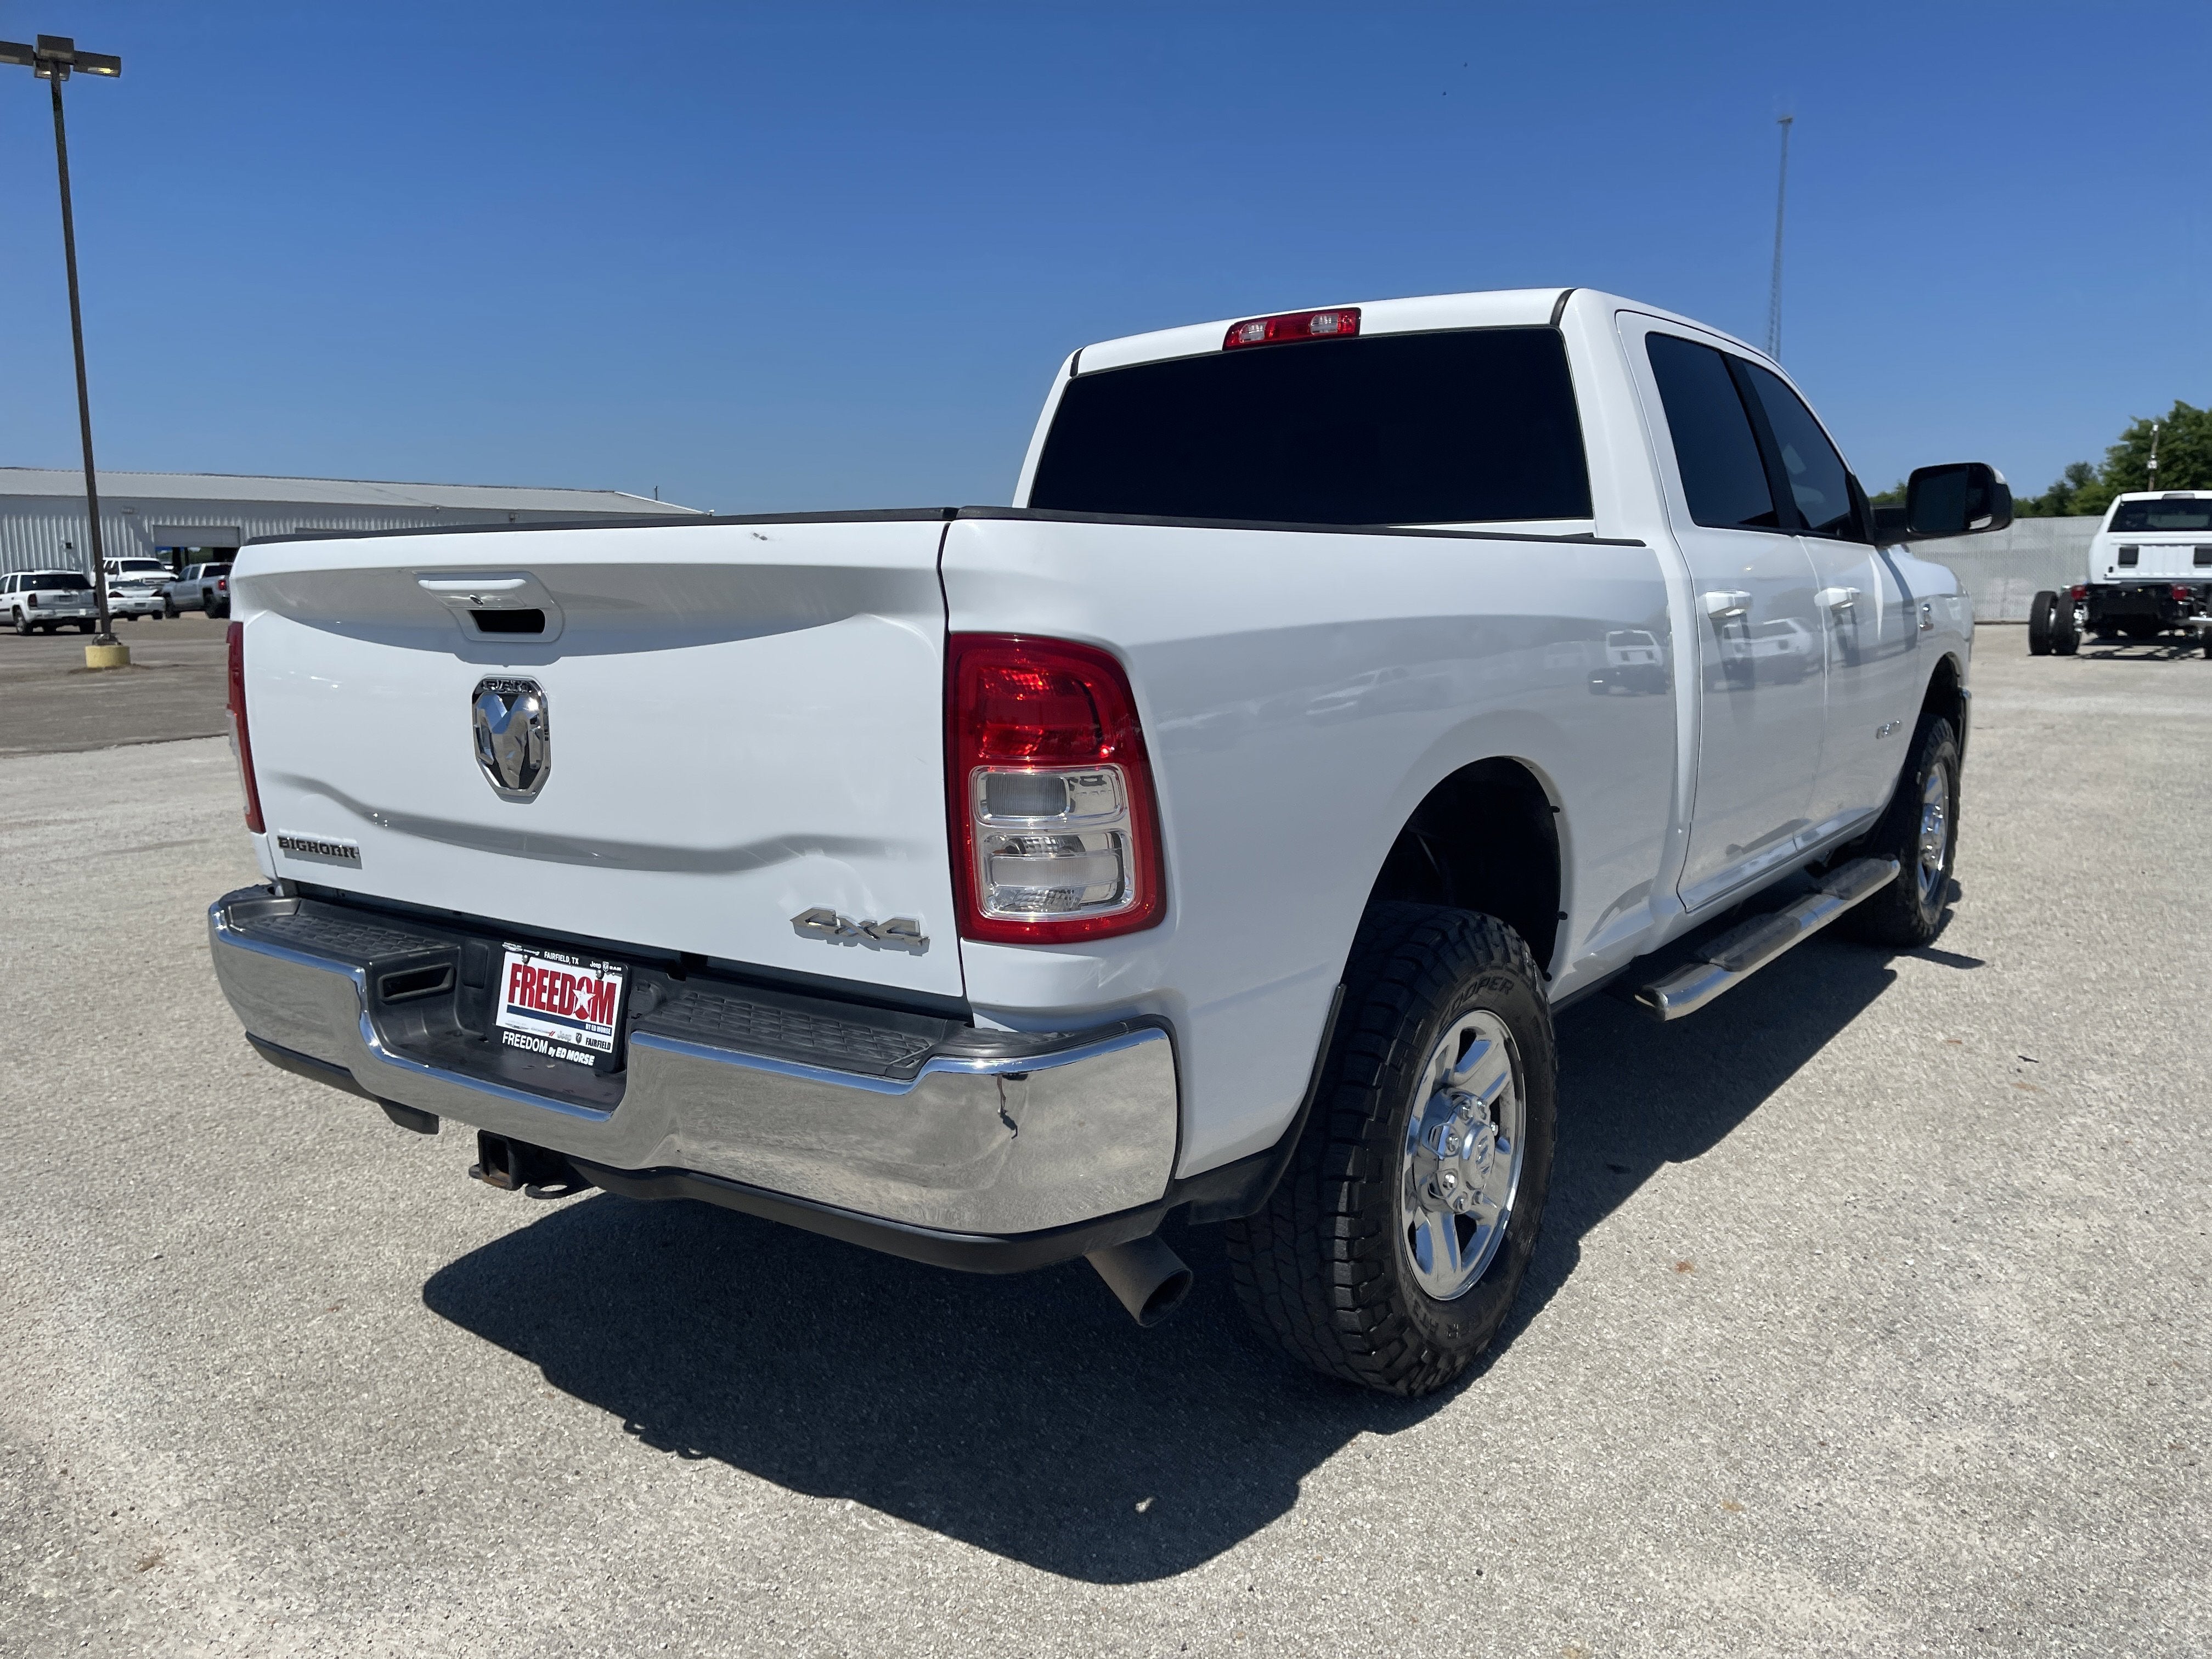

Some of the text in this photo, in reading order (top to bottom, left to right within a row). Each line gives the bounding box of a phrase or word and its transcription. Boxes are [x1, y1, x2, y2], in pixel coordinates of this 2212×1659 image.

[544, 951, 571, 964] FAIRFIELD,
[571, 956, 579, 965] TX
[590, 961, 601, 969] Jeep
[507, 962, 617, 1025] FREEDOM
[596, 1025, 611, 1035] MORSE
[502, 1031, 549, 1054] FREEDOM
[556, 1047, 567, 1059] ED
[566, 1049, 596, 1066] MORSE
[585, 1037, 611, 1051] FAIRFIELD
